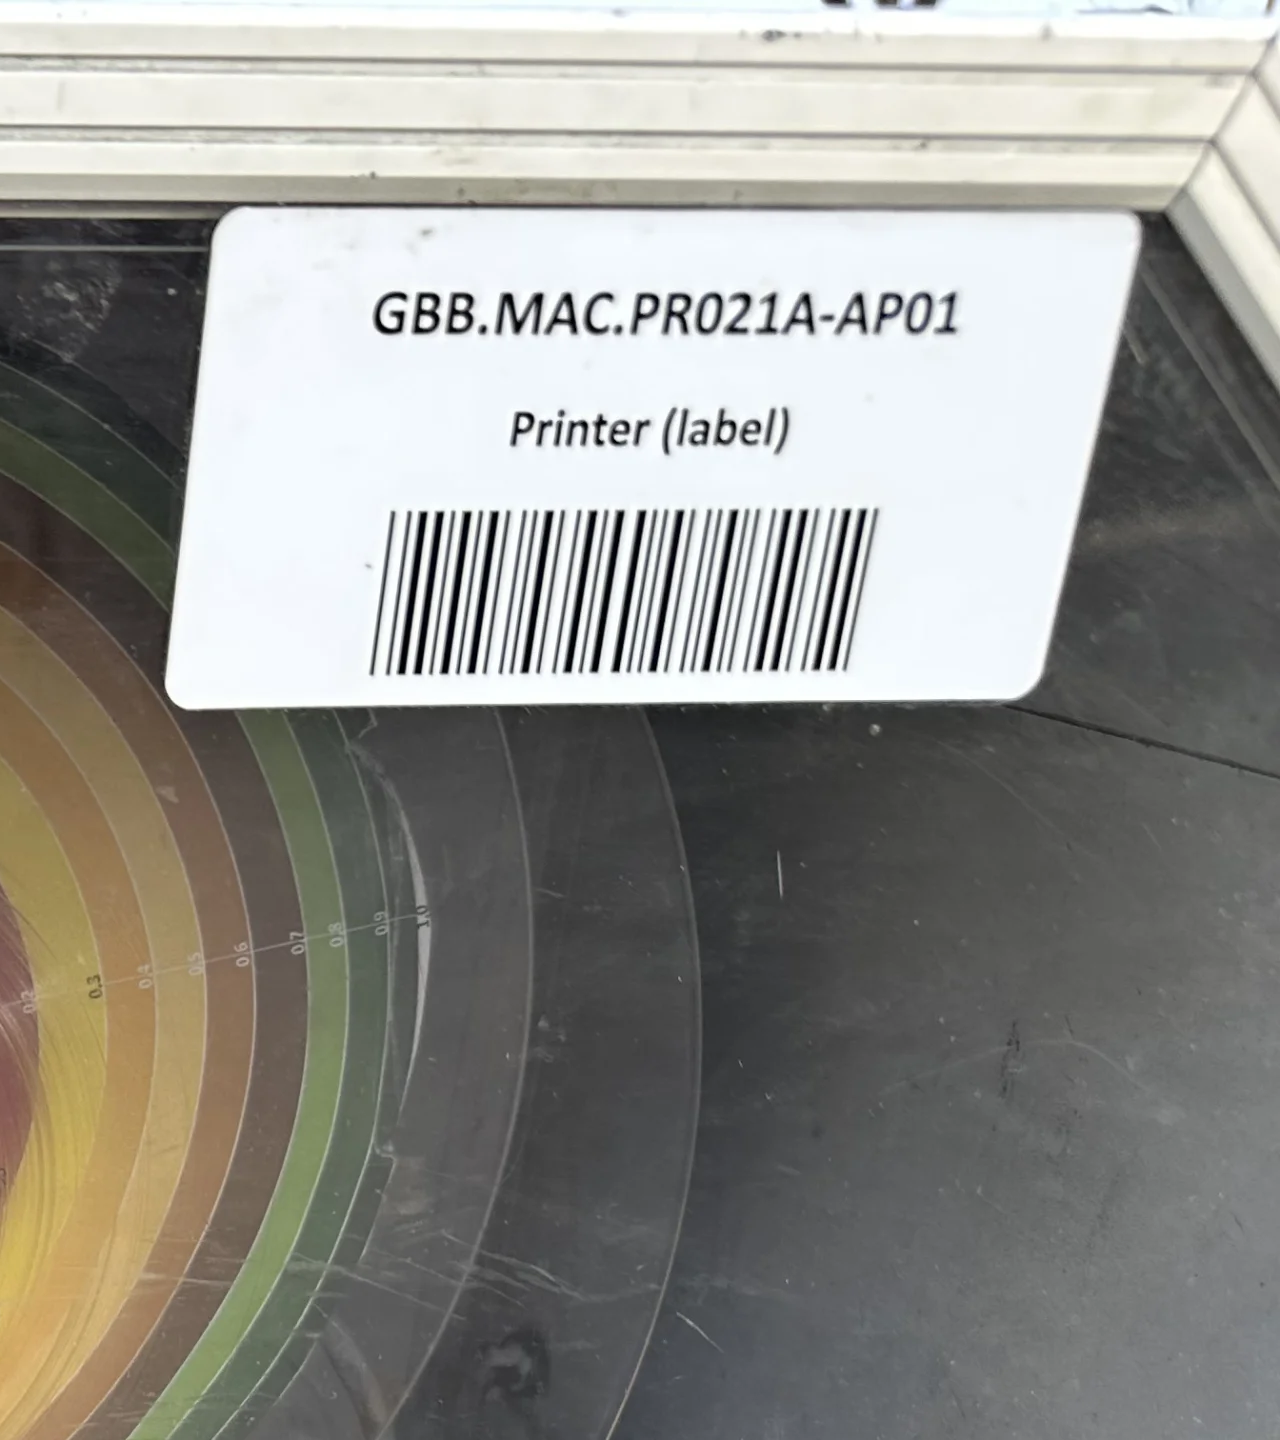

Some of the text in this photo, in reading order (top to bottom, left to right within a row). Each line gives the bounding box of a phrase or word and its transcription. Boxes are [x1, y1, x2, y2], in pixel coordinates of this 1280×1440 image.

[373, 291, 957, 335] GBB.MAC.PR021A-AP01
[510, 407, 789, 455] Printer (label)
